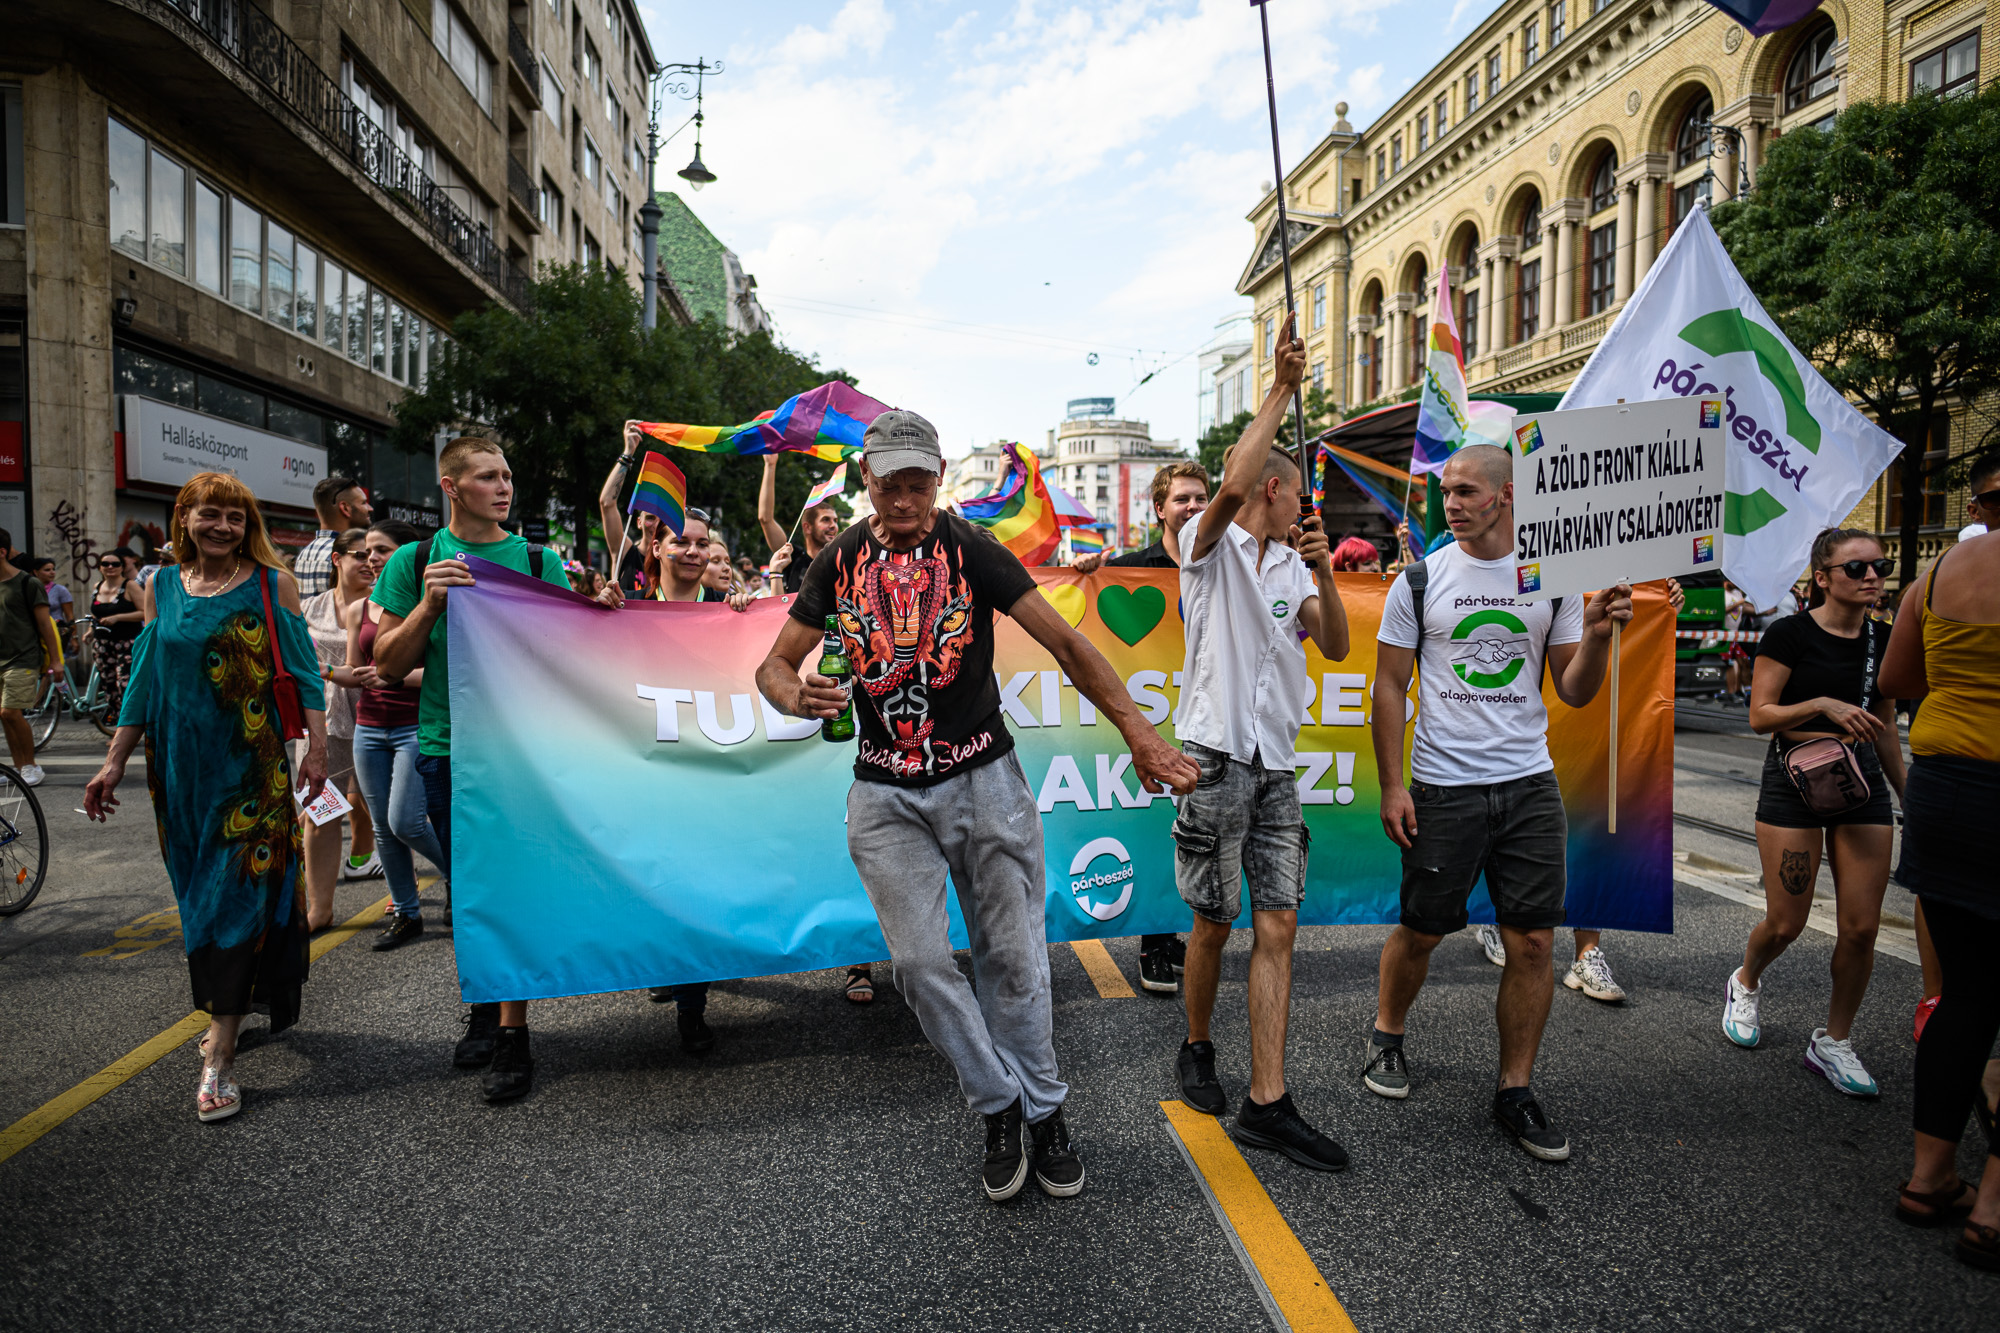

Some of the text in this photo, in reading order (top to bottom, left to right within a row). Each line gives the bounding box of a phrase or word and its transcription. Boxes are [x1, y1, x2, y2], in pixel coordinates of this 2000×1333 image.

[162, 422, 248, 461] Hallásközpont
[0, 455, 15, 465] lés
[282, 456, 315, 478] signia
[1535, 428, 1704, 495] A ZÖLD FRONT KIÁLL A
[388, 506, 412, 524] VISION
[1517, 485, 1722, 560] SZIVÁRVÁNY CSALÁDOKÉRT
[1454, 595, 1533, 609] párbesz
[1866, 657, 1874, 672] FILA
[1440, 689, 1527, 704] alapjövedelem
[1071, 863, 1134, 896] párbeszéd
